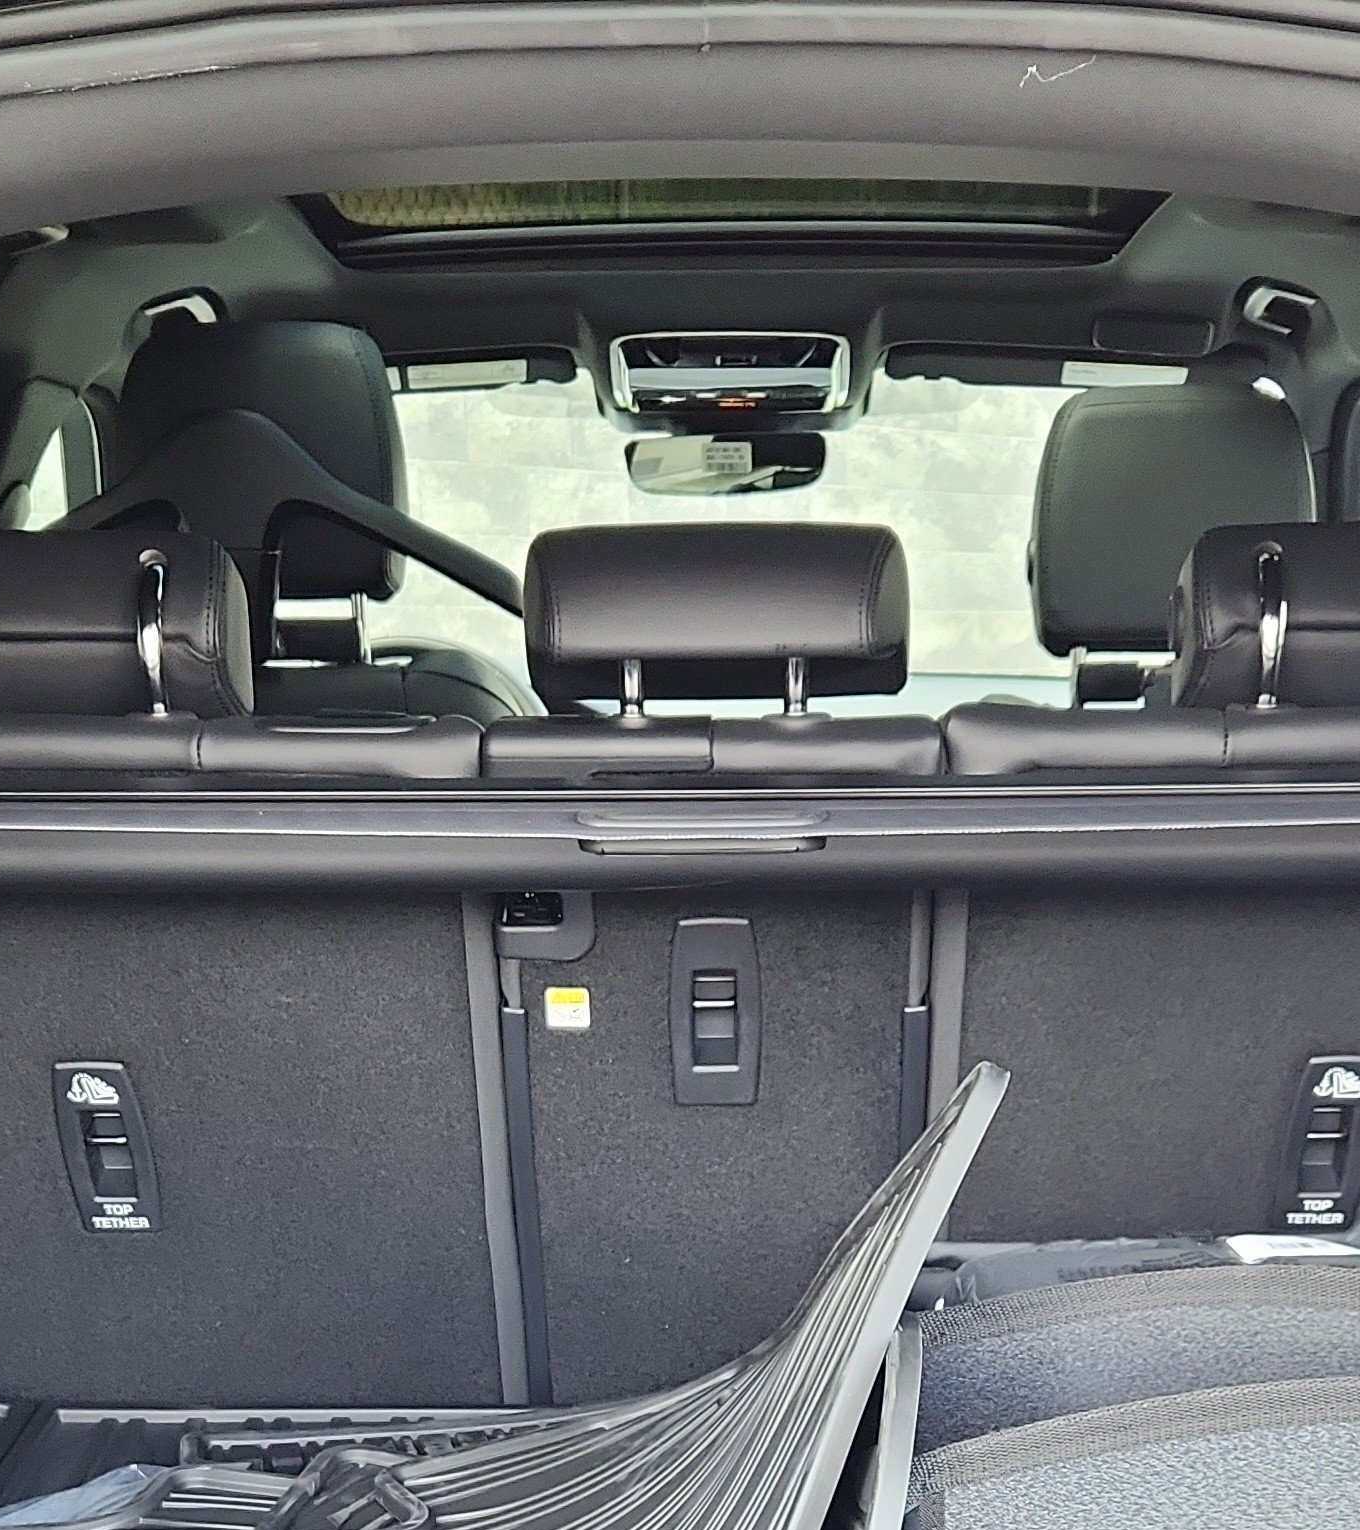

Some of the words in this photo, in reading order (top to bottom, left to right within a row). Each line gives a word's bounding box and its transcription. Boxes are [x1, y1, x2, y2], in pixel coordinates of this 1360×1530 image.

[102, 1203, 134, 1216] TOP
[1302, 1199, 1334, 1211] TOP
[91, 1216, 151, 1229] TETHER
[1285, 1212, 1345, 1225] TETHER
